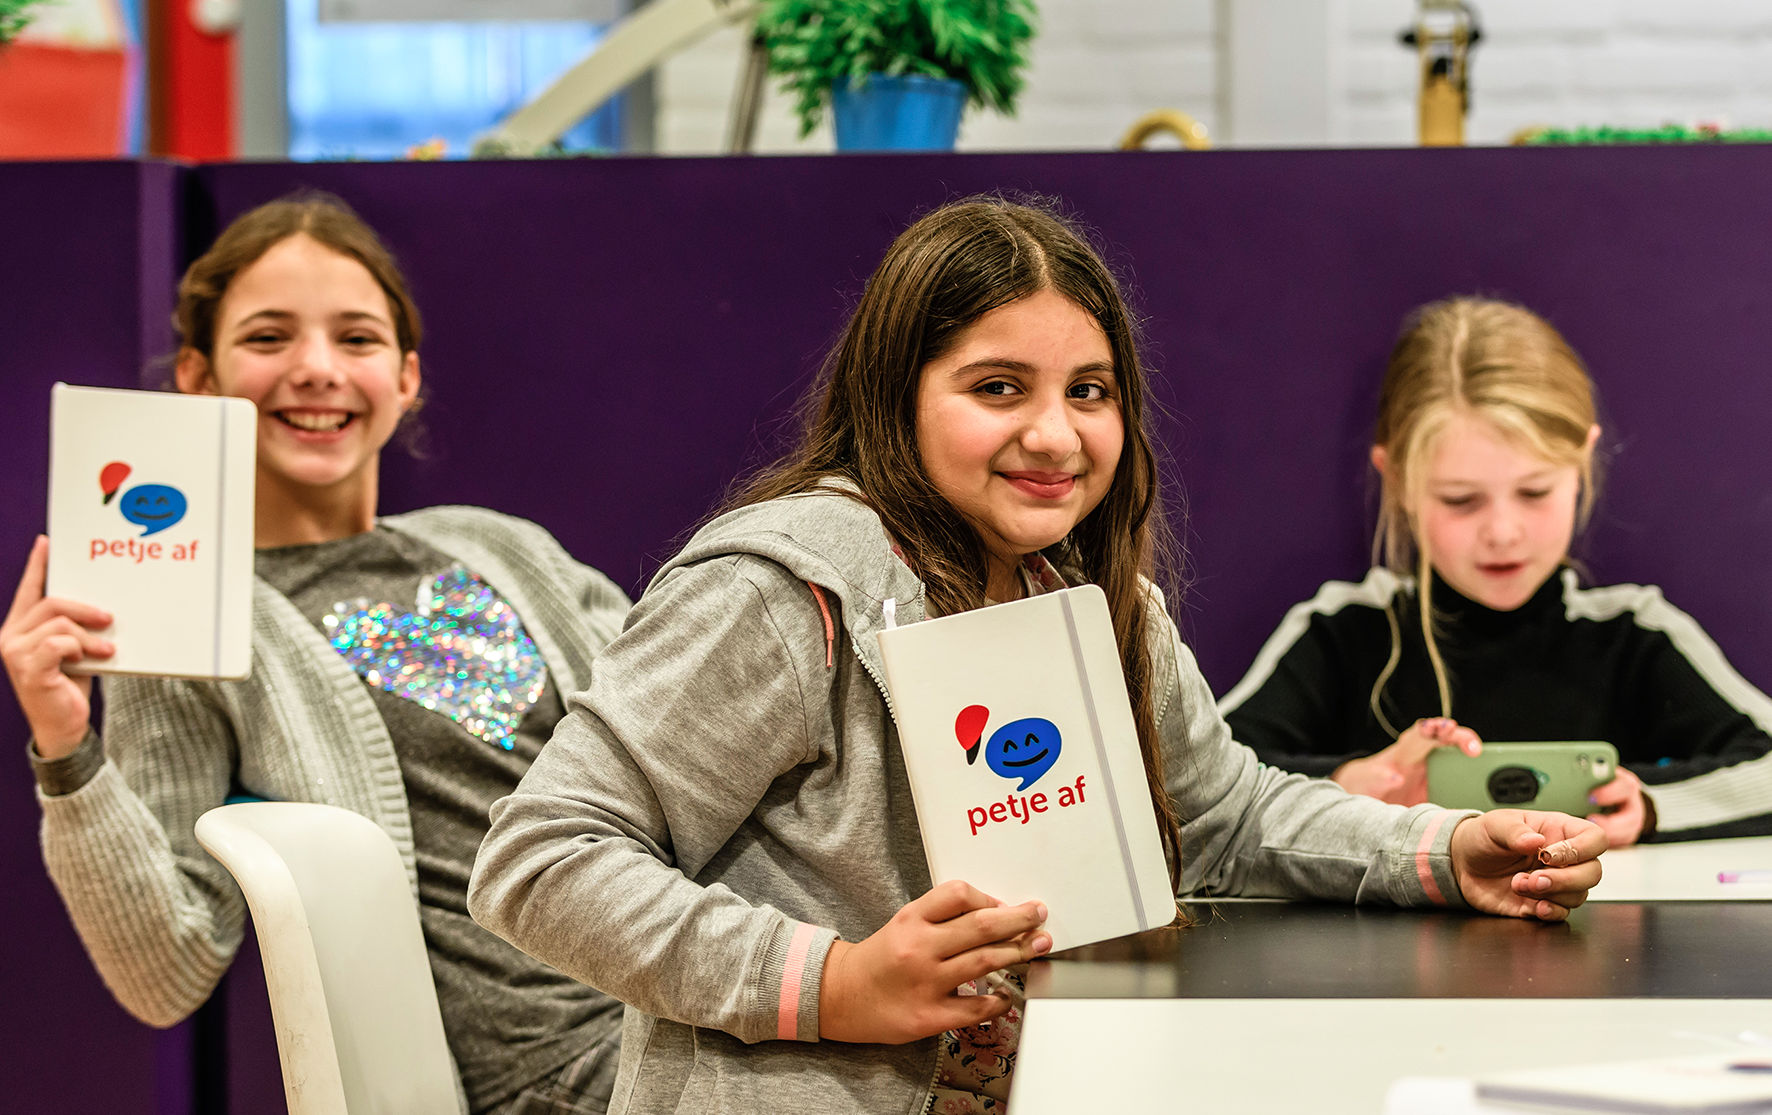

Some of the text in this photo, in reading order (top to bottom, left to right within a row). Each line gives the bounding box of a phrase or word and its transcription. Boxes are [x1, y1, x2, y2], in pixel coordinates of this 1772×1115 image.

[90, 538, 199, 564] petje af
[967, 775, 1086, 836] petje af
